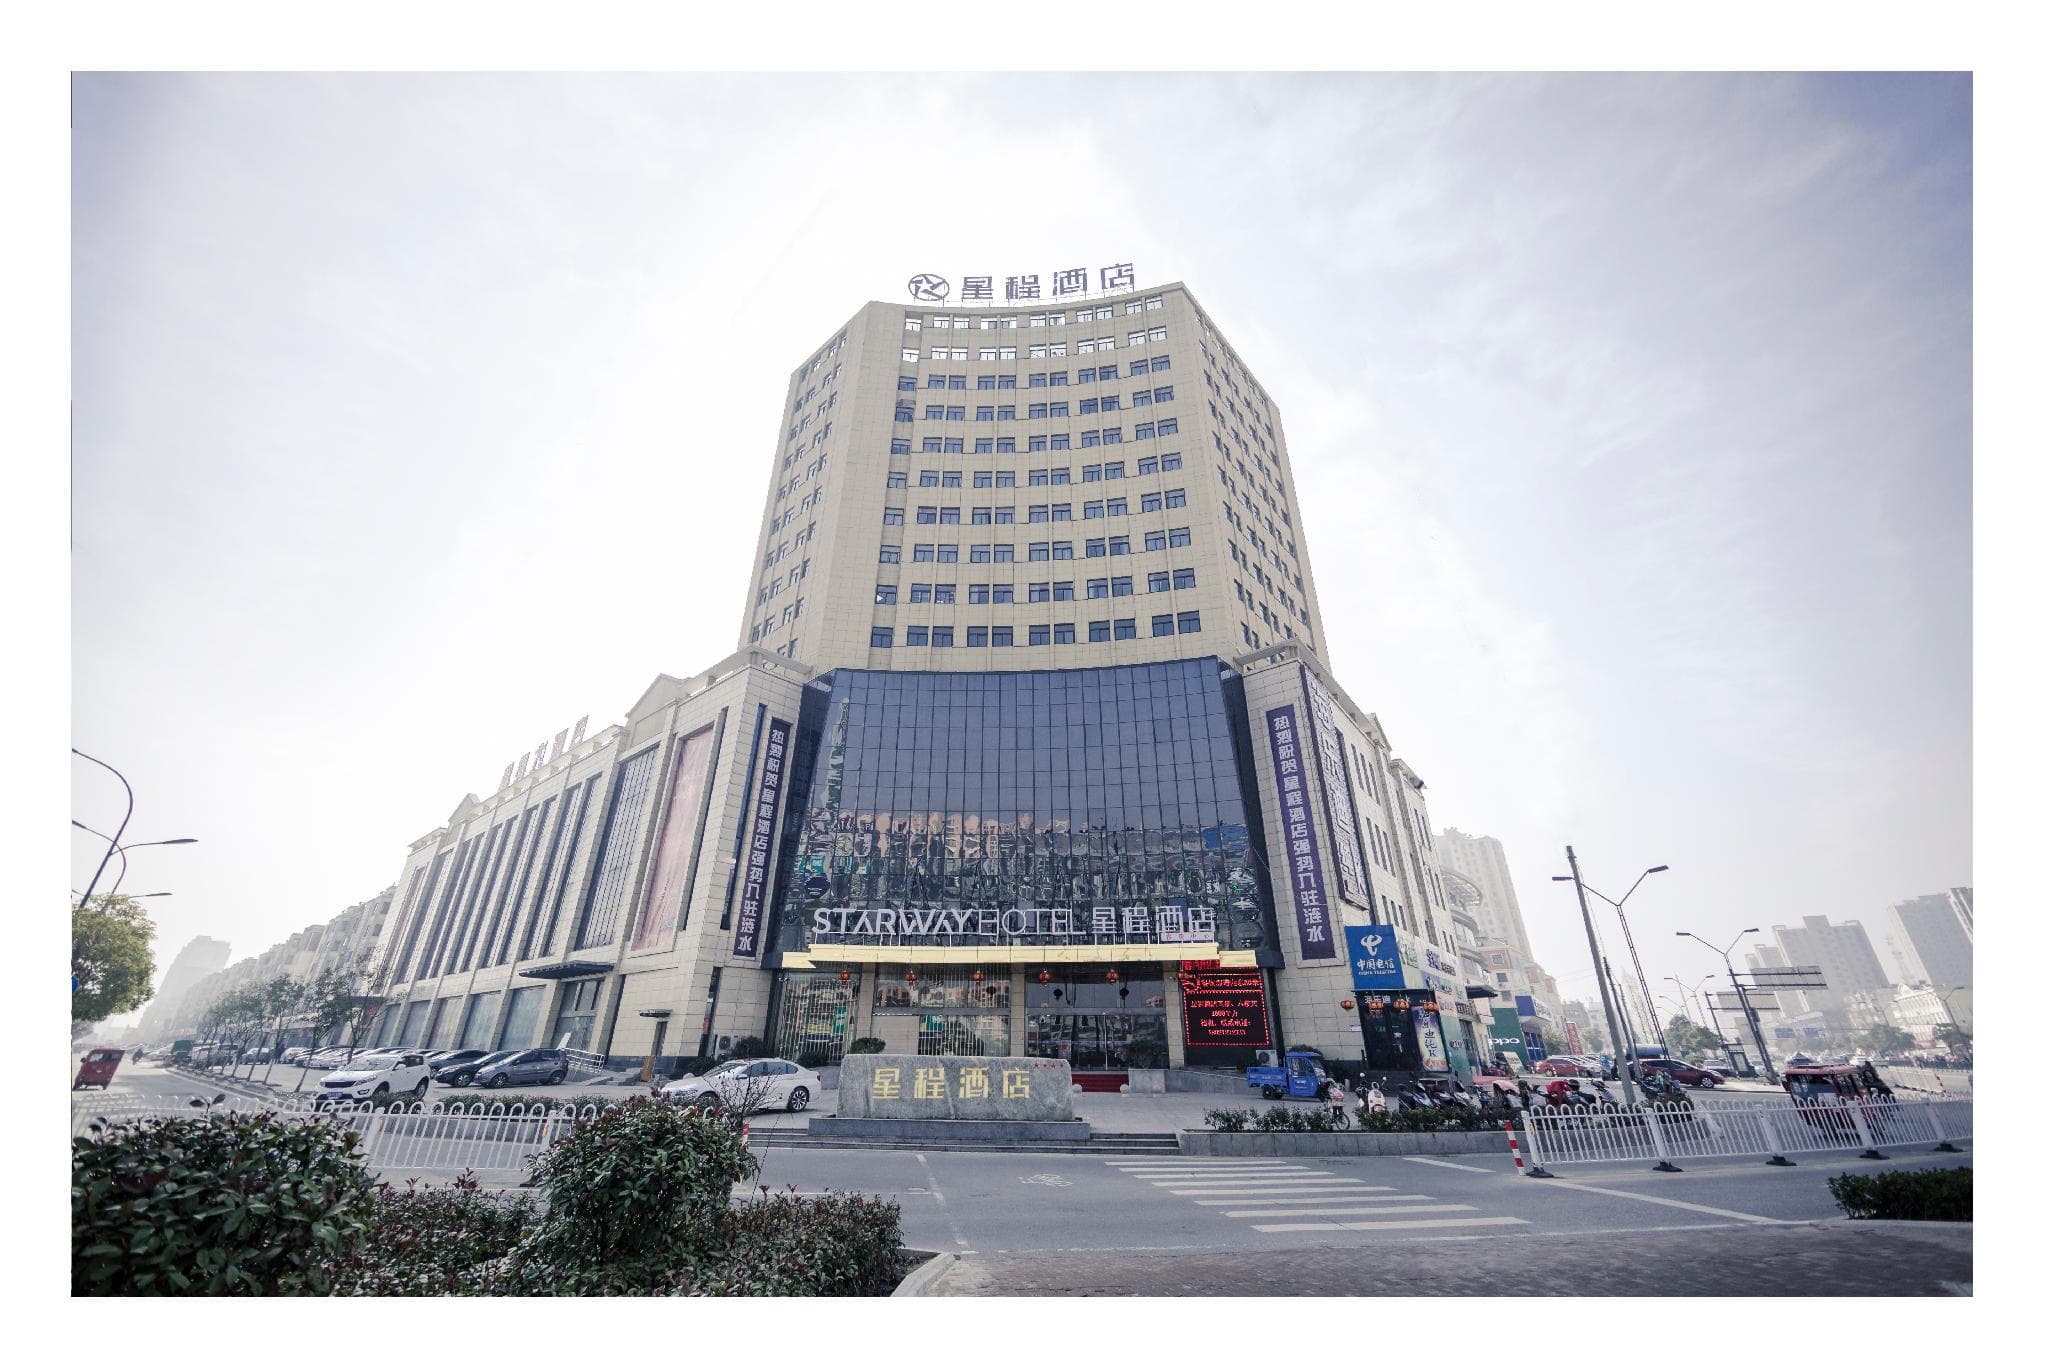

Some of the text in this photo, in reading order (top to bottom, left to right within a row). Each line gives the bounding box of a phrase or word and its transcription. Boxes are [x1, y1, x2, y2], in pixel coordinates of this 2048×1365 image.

[962, 263, 1135, 300] 星程酒店
[1092, 905, 1216, 935] 星程酒店
[1356, 958, 1395, 971] 中国电信
[872, 1067, 1031, 1100] 星程酒店
